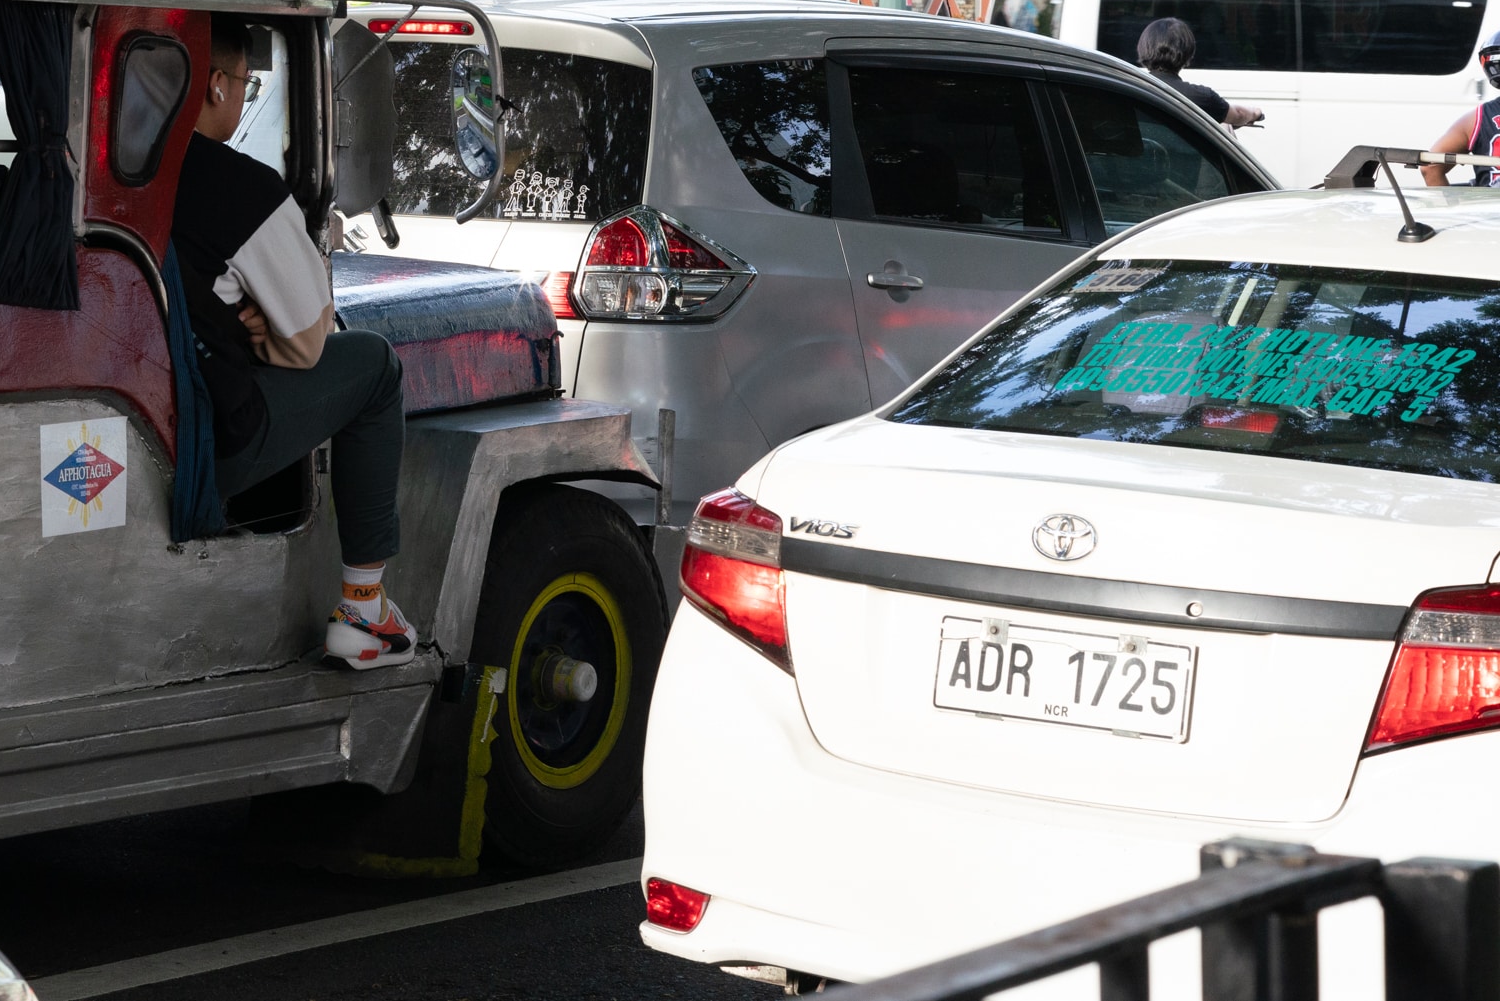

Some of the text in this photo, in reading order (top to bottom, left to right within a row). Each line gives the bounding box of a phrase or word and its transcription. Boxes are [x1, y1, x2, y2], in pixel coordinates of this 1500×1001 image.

[1099, 321, 1194, 345] LTFRB
[1187, 323, 1267, 350] 24/7
[1393, 342, 1477, 373] 1342
[1326, 385, 1394, 417] CAP.
[1400, 395, 1436, 423] 5
[58, 462, 113, 483] AFPHOTAGUA
[948, 640, 1179, 716] ADR 1725
[1043, 704, 1069, 718] NCR
